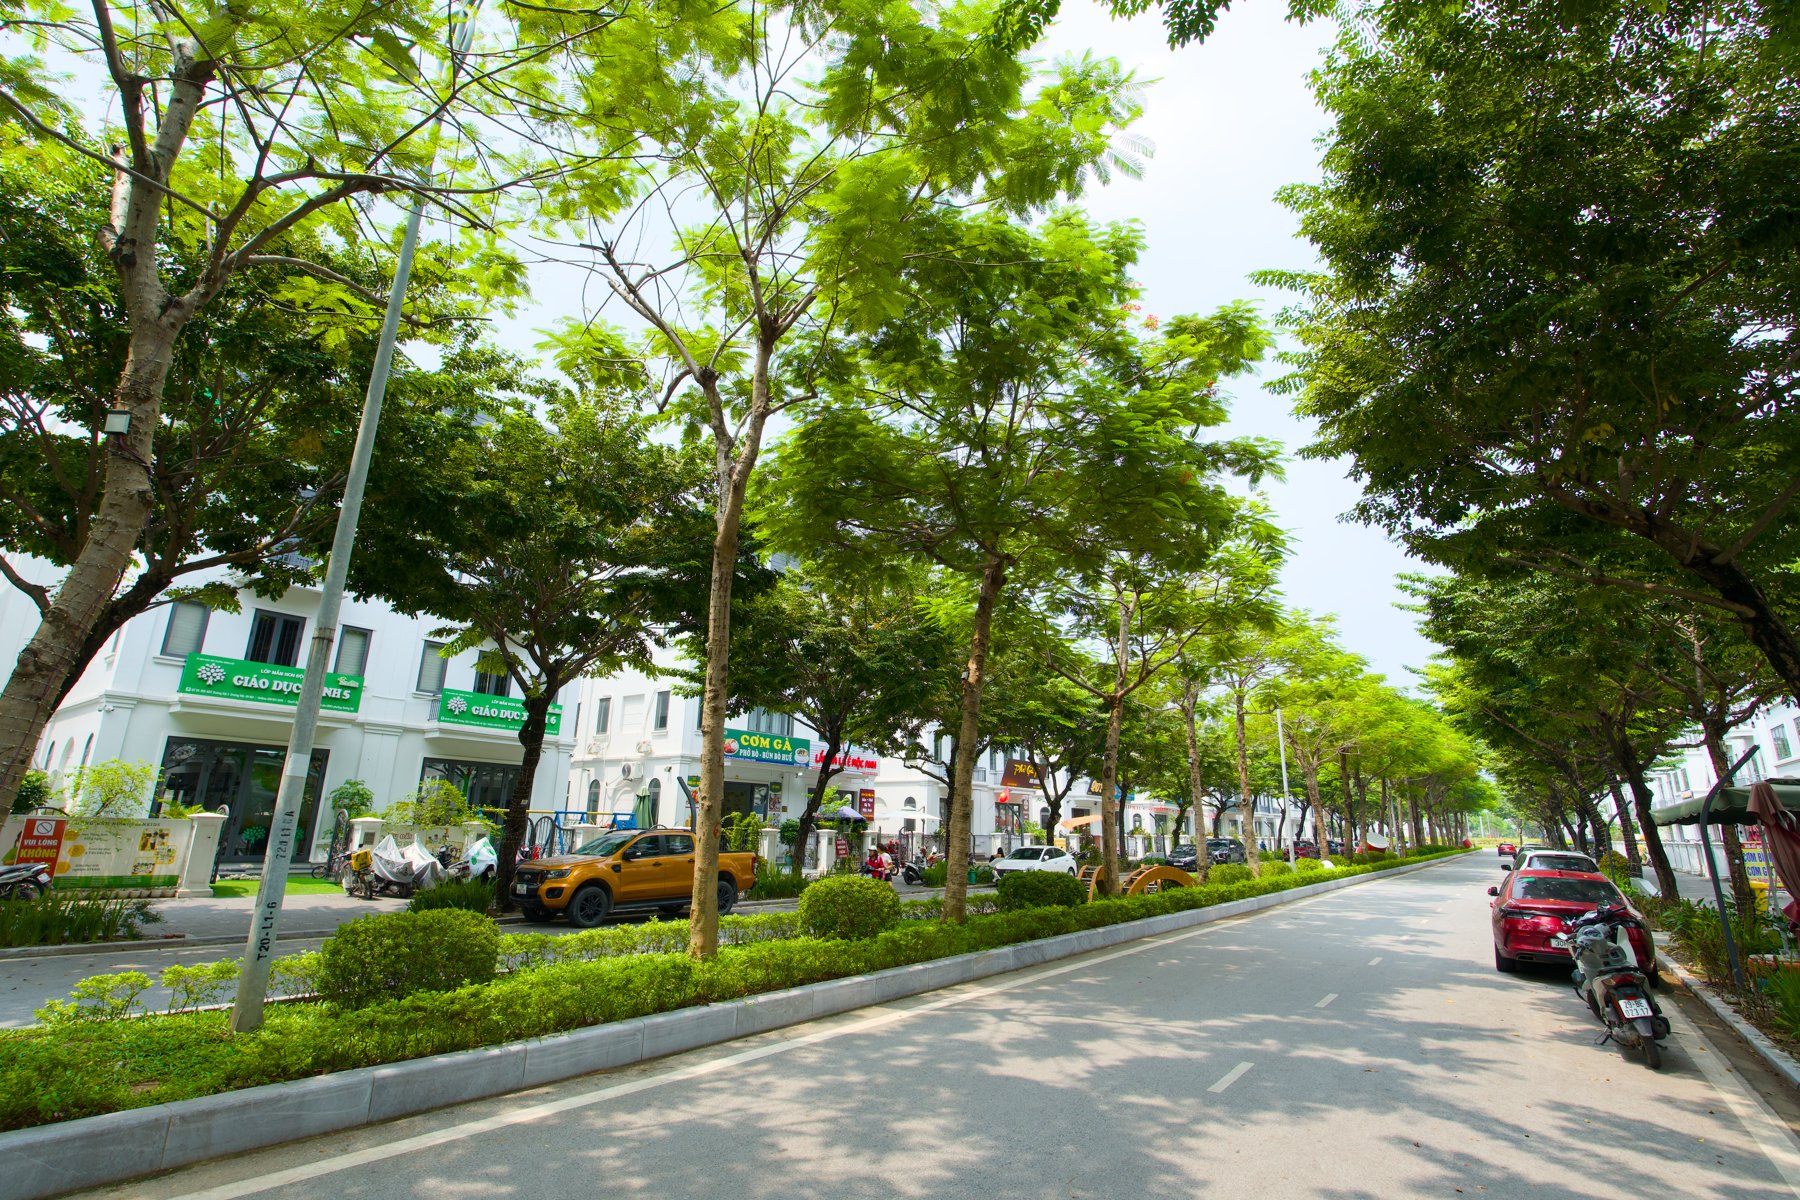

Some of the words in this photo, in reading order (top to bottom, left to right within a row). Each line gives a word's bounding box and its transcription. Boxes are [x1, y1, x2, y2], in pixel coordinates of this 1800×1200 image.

[232, 674, 269, 689] GIÁO
[271, 680, 303, 695] DỤC
[342, 689, 351, 700] 5
[471, 705, 498, 717] GIÁO
[499, 709, 520, 721] DỤC
[550, 715, 557, 725] 6
[740, 734, 770, 748] CƠM
[773, 738, 792, 751] GÀ
[781, 752, 793, 761] HUẾ
[38, 837, 58, 846] LÒNG
[20, 847, 57, 858] KHÔNG
[256, 901, 277, 962] T20-L1-6
